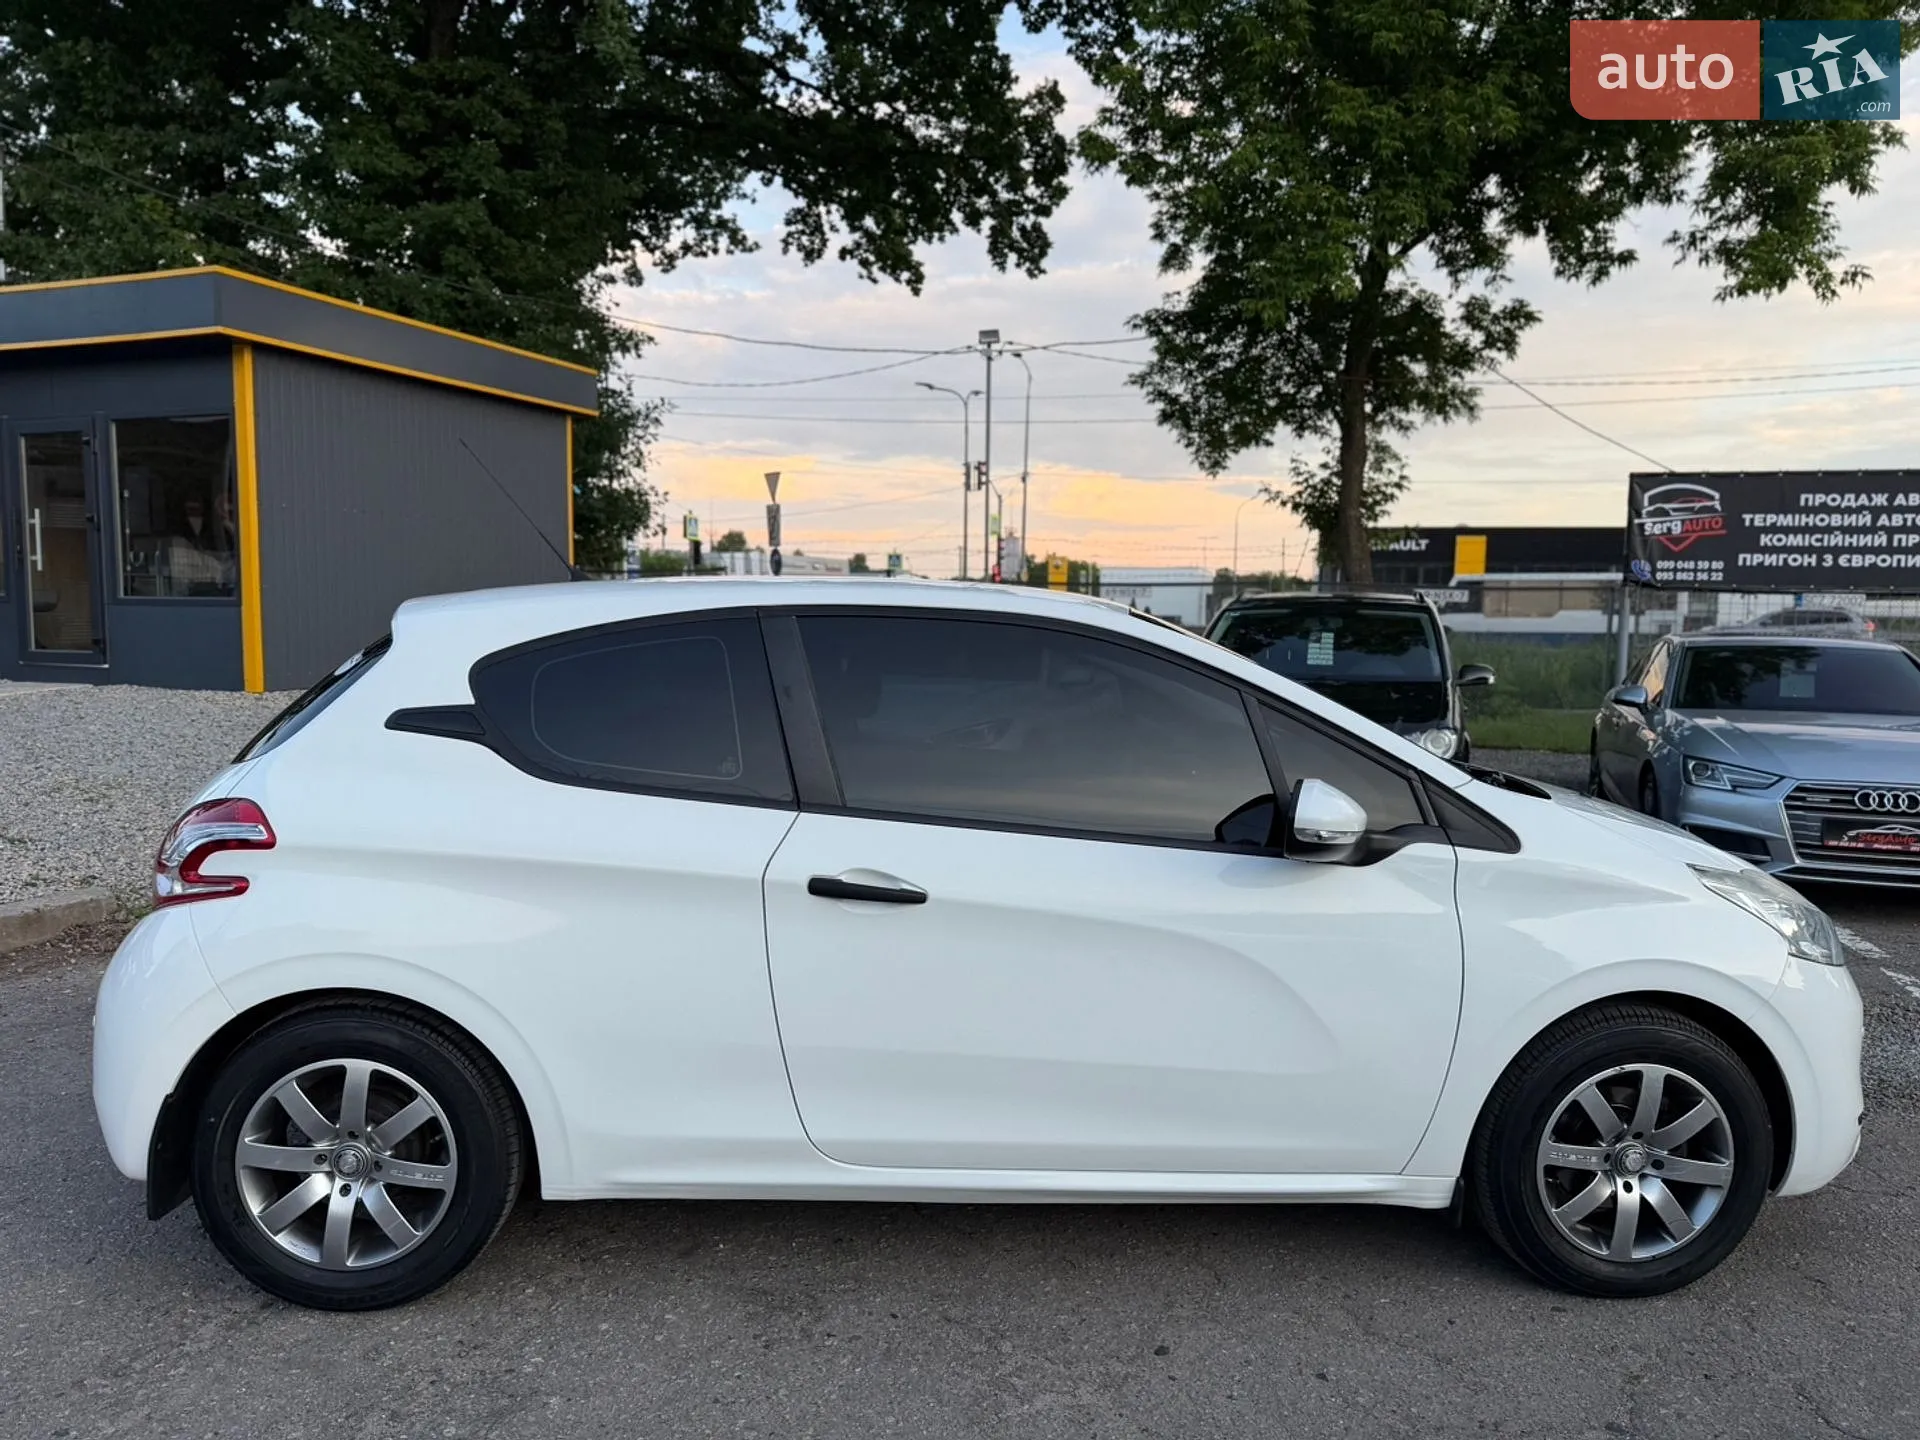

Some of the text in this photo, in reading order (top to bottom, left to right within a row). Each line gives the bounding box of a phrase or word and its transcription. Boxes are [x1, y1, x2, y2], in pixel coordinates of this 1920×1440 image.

[1799, 492, 1888, 508] ПРОДАЖ
[1741, 511, 1871, 527] ТЕРМІНОВИЙ
[1760, 531, 1887, 547] КОМІСІЙНИЙ
[1737, 553, 1817, 567] ПРИГОН
[1838, 554, 1920, 568] ЄВРОПИ
[1710, 571, 1724, 580] 22
